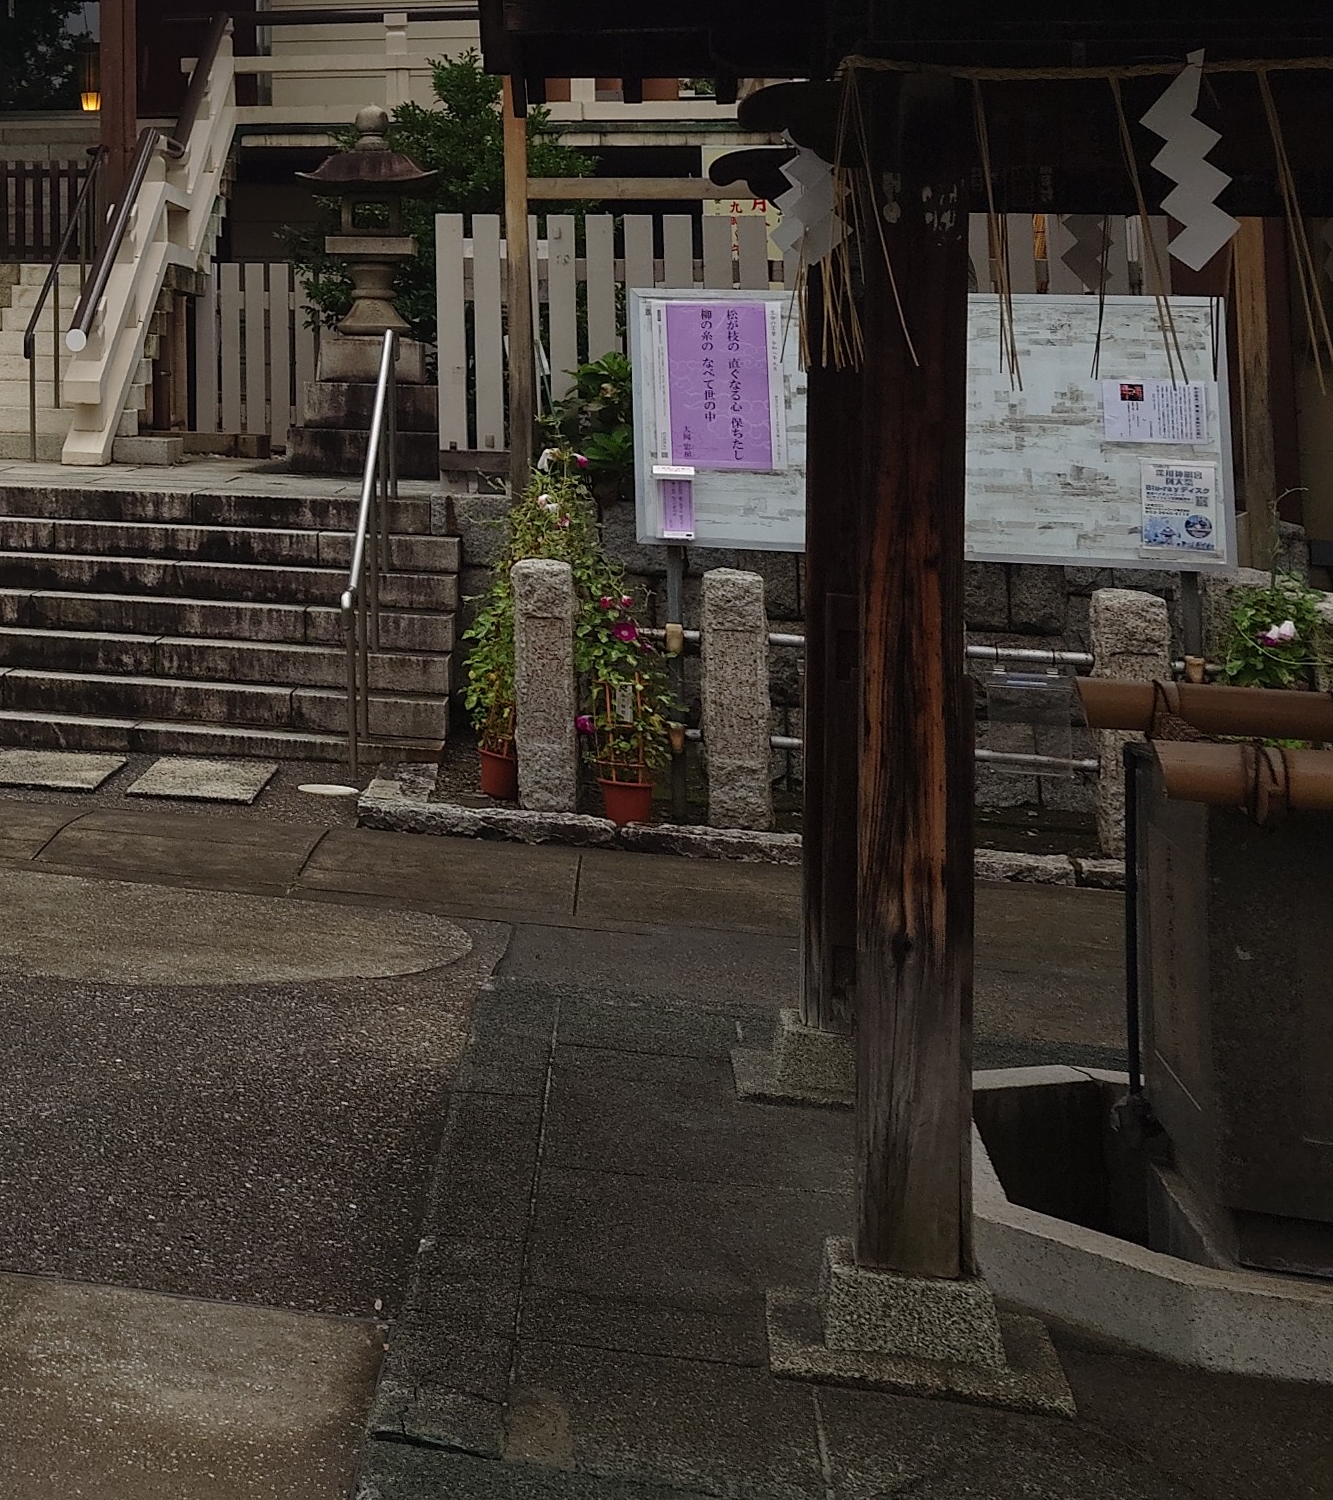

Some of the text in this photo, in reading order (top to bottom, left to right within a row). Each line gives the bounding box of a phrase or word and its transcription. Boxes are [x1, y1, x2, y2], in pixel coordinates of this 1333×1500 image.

[700, 309, 716, 422] 柳の糸の なべて世の中
[726, 309, 744, 461] 松が枝の 直ぐなる心 保ちたし
